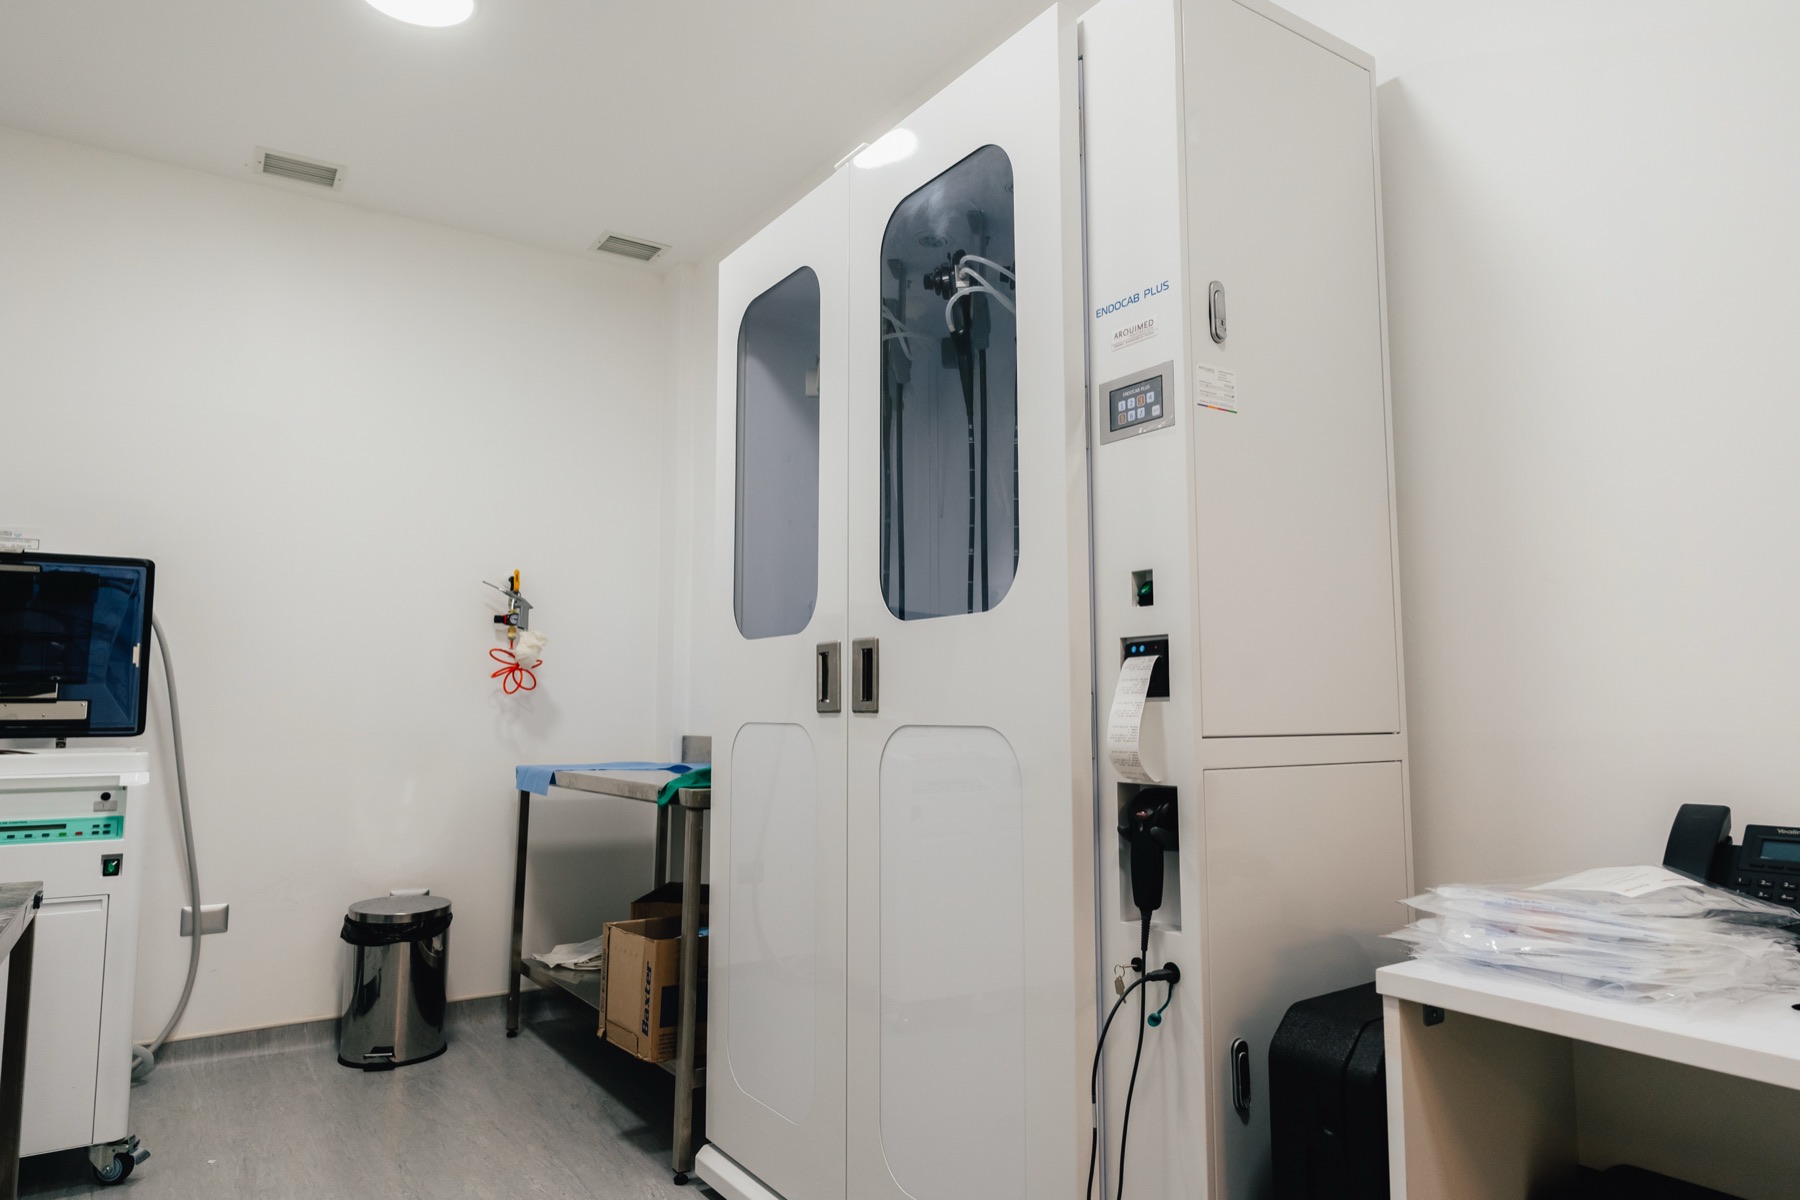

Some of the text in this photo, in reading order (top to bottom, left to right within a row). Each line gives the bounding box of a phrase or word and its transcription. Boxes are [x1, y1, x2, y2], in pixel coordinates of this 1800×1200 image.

[1095, 280, 1170, 318] ENDOCAB PLUS
[1123, 387, 1140, 397] ENDOCAB
[641, 961, 653, 1037] Baxter
